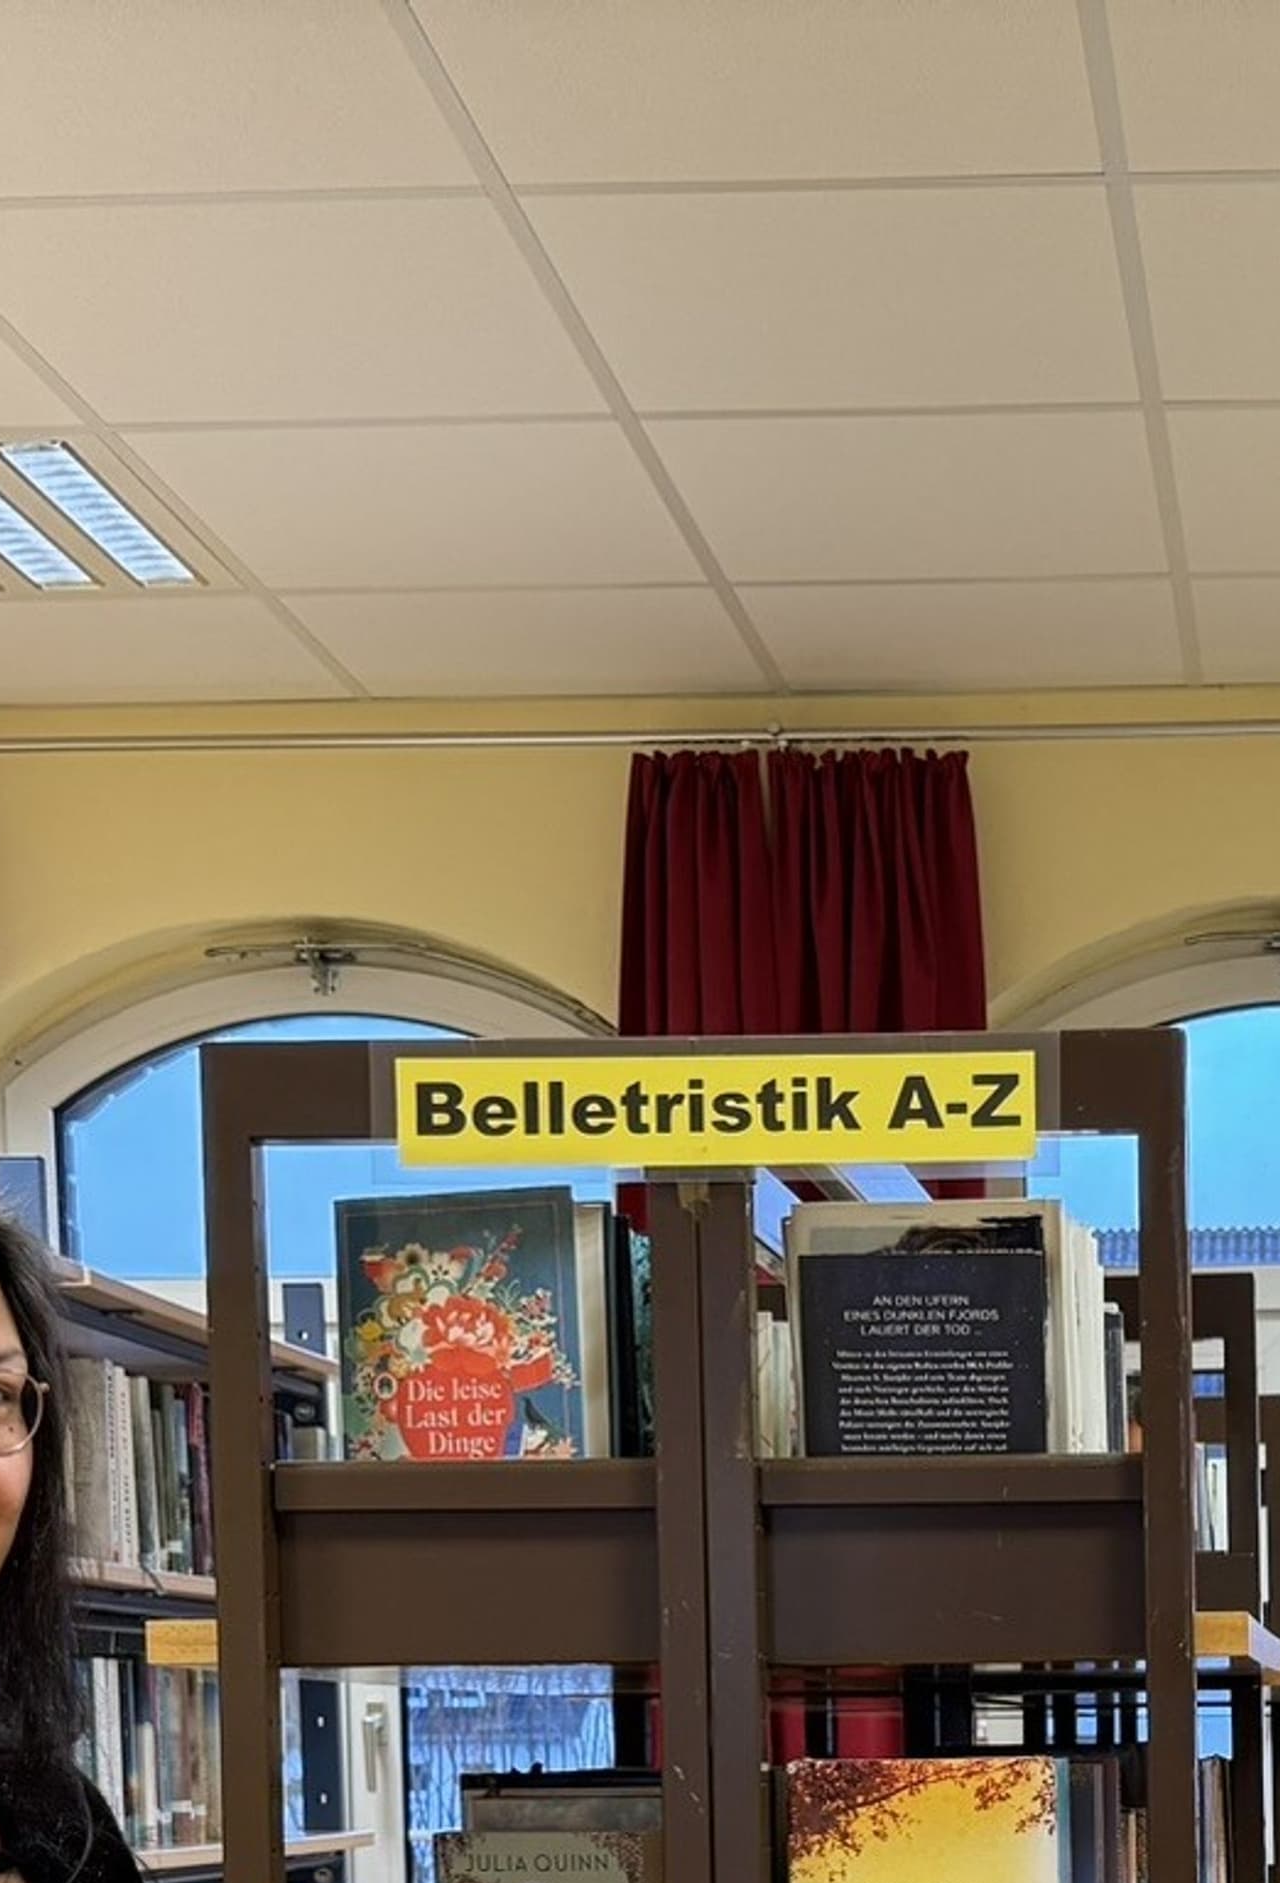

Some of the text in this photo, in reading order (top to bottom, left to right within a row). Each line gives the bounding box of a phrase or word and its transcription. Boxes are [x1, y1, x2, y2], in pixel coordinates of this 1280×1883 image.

[415, 1073, 1021, 1137] Belletristik A-Z
[872, 1295, 893, 1306] AN
[895, 1295, 922, 1306] DEN
[843, 1309, 1000, 1321] EINES DUNKLEN FJORDS
[860, 1324, 910, 1335] LAUERT
[913, 1324, 941, 1335] DER
[944, 1324, 971, 1335] TOD
[407, 1377, 502, 1402] Die leise
[405, 1401, 507, 1429] Last der
[428, 1430, 497, 1459] Dinge
[465, 1853, 610, 1873] JULIA QUINN
